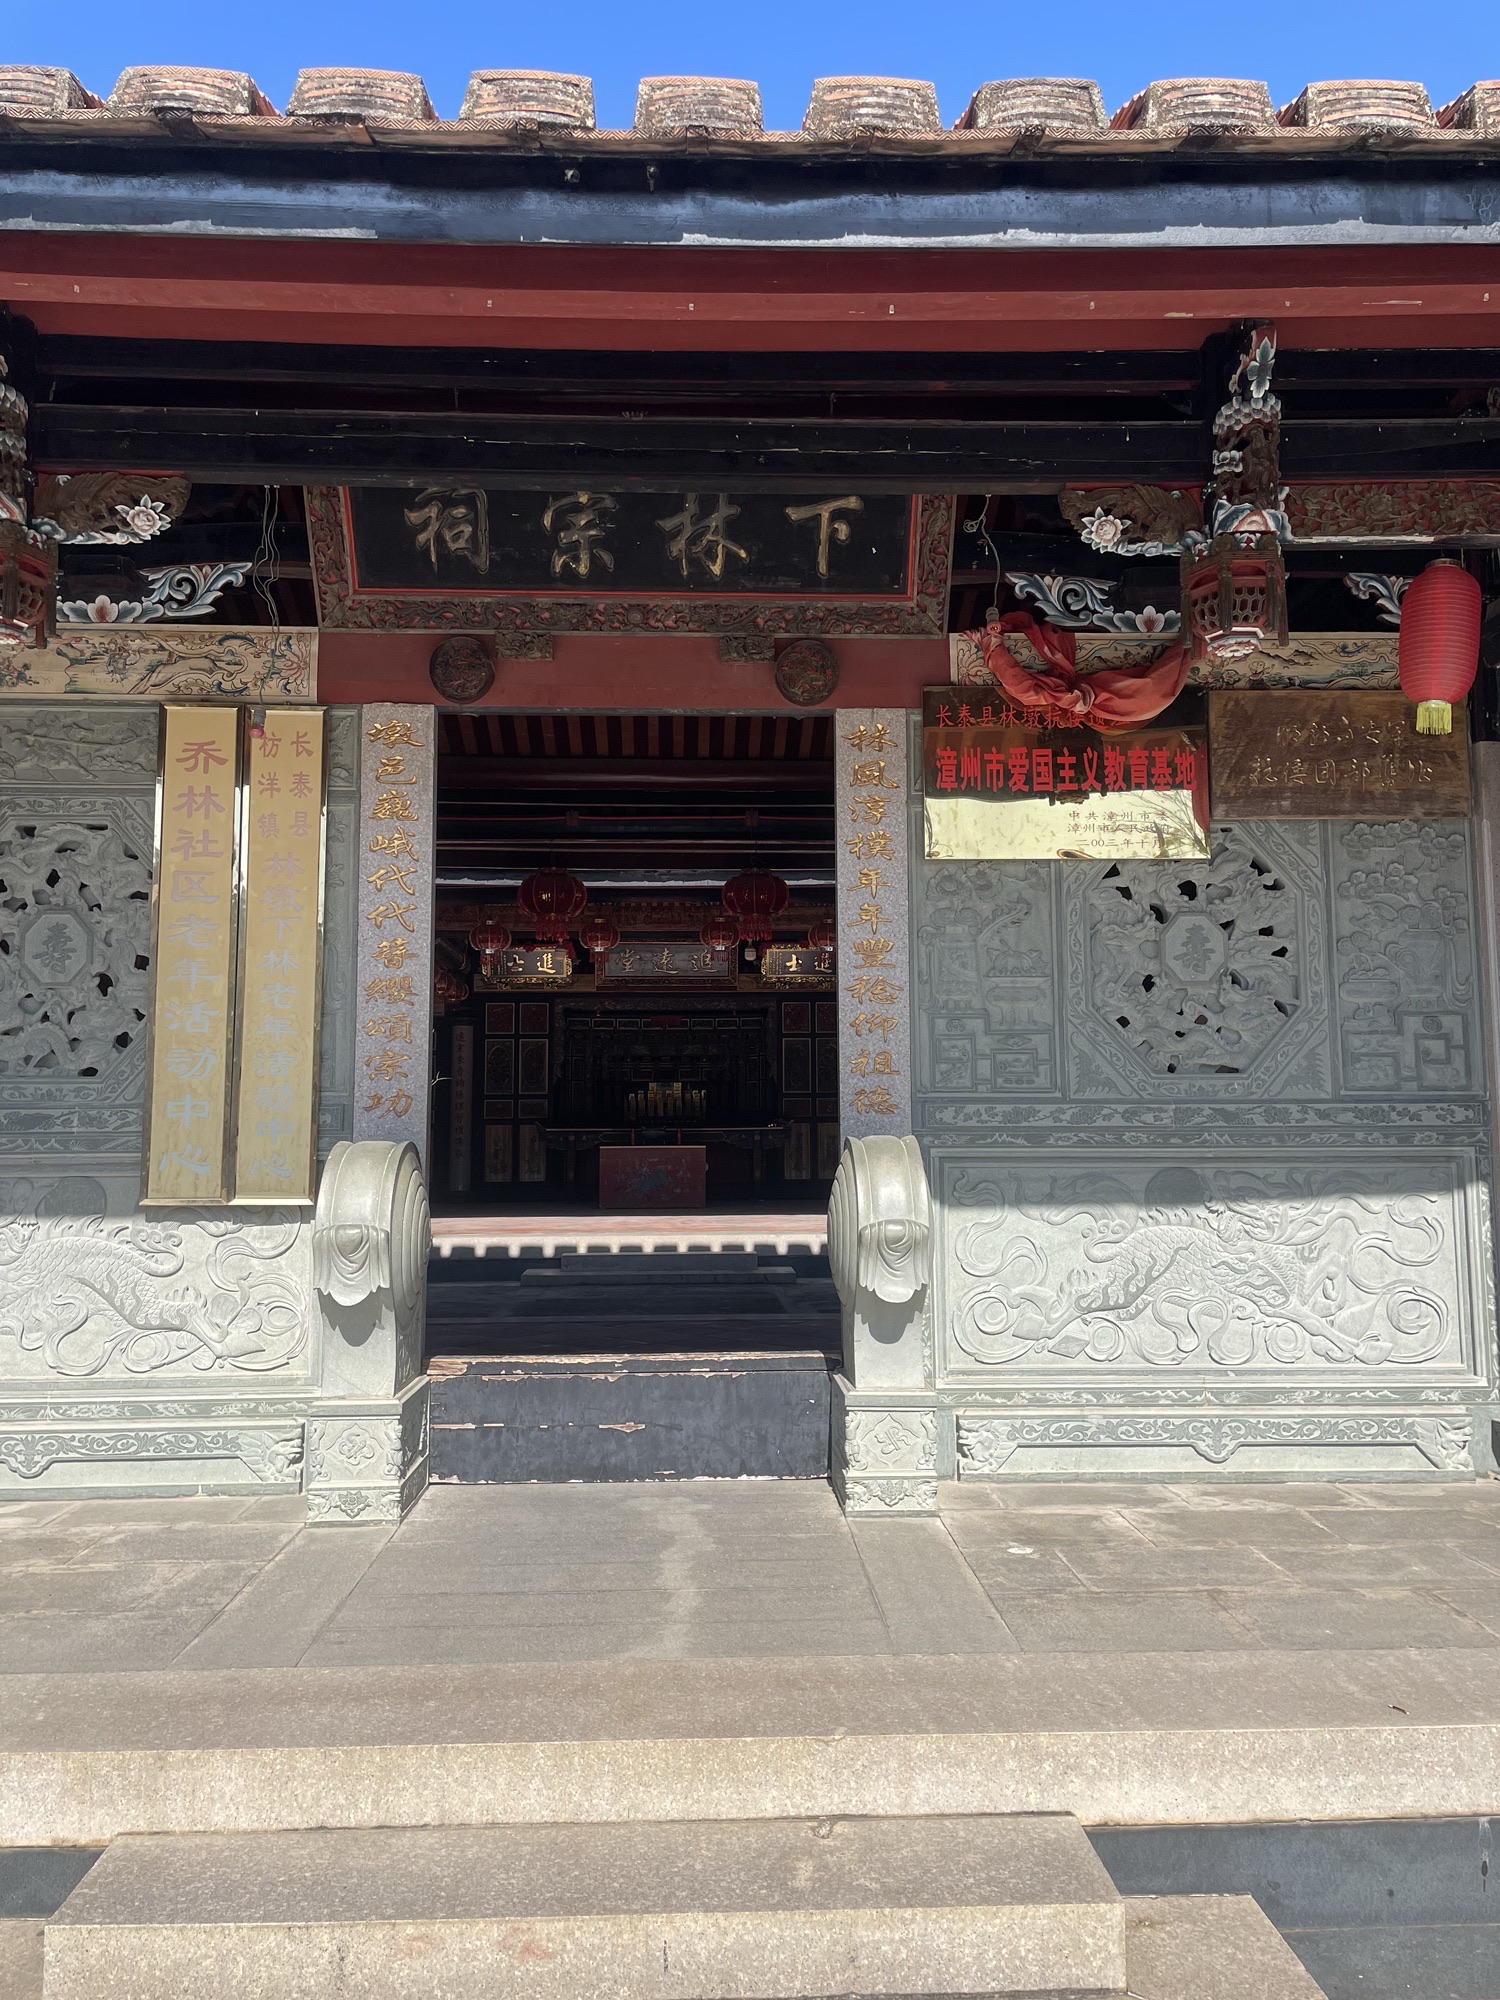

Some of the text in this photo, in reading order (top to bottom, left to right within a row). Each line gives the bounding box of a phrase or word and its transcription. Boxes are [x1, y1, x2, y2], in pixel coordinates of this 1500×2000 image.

[403, 486, 865, 579] 下林宗祠
[257, 730, 282, 839] 枋洋镇
[289, 730, 314, 839] 长泰县
[935, 746, 1198, 792] 漳州市爱国主义教育基地
[1068, 810, 1170, 822] 中共漳州市委
[1067, 822, 1170, 834] 漳州市人民政府
[158, 740, 229, 1177] 乔林社区老年活动中心
[249, 851, 306, 1178] 林墩下林老年活动中心
